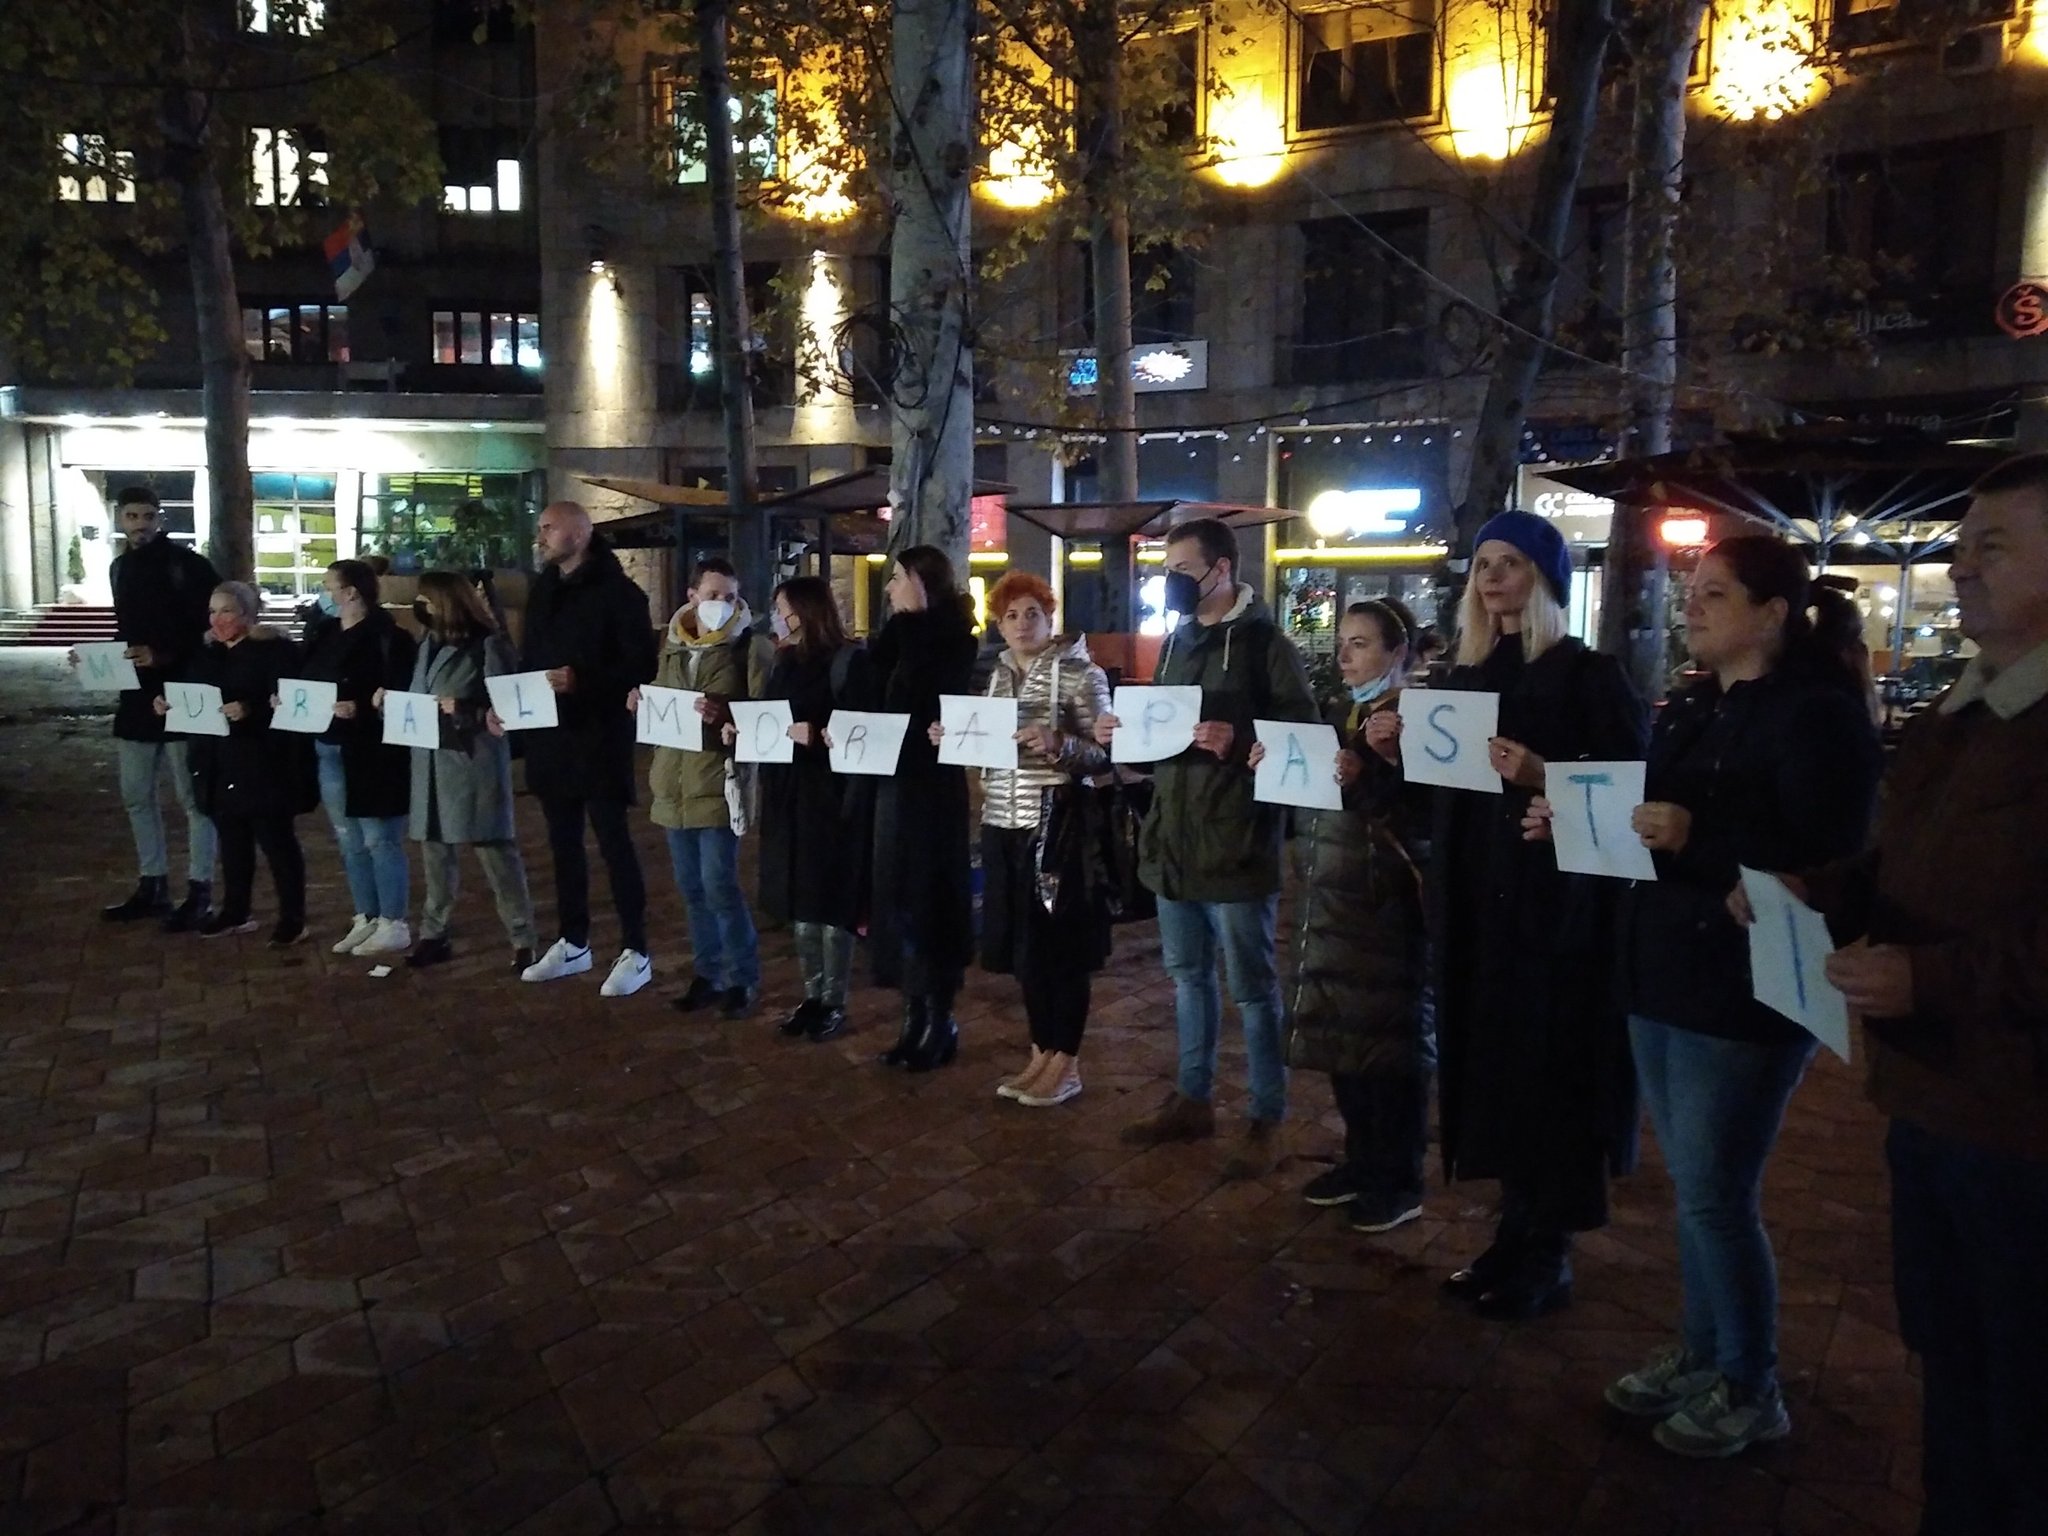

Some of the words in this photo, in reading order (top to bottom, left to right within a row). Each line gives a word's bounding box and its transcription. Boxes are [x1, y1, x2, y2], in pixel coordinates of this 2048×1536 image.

[86, 652, 117, 680] M
[182, 690, 205, 719] U
[292, 687, 310, 719] R
[402, 699, 417, 734] A
[515, 682, 534, 718] L
[646, 695, 682, 735] M
[754, 711, 781, 756] O
[954, 711, 990, 754] A
[1142, 698, 1178, 747] P
[1424, 703, 1459, 764] S
[844, 724, 867, 765] R
[1280, 732, 1310, 788] A
[1567, 772, 1615, 850] T
